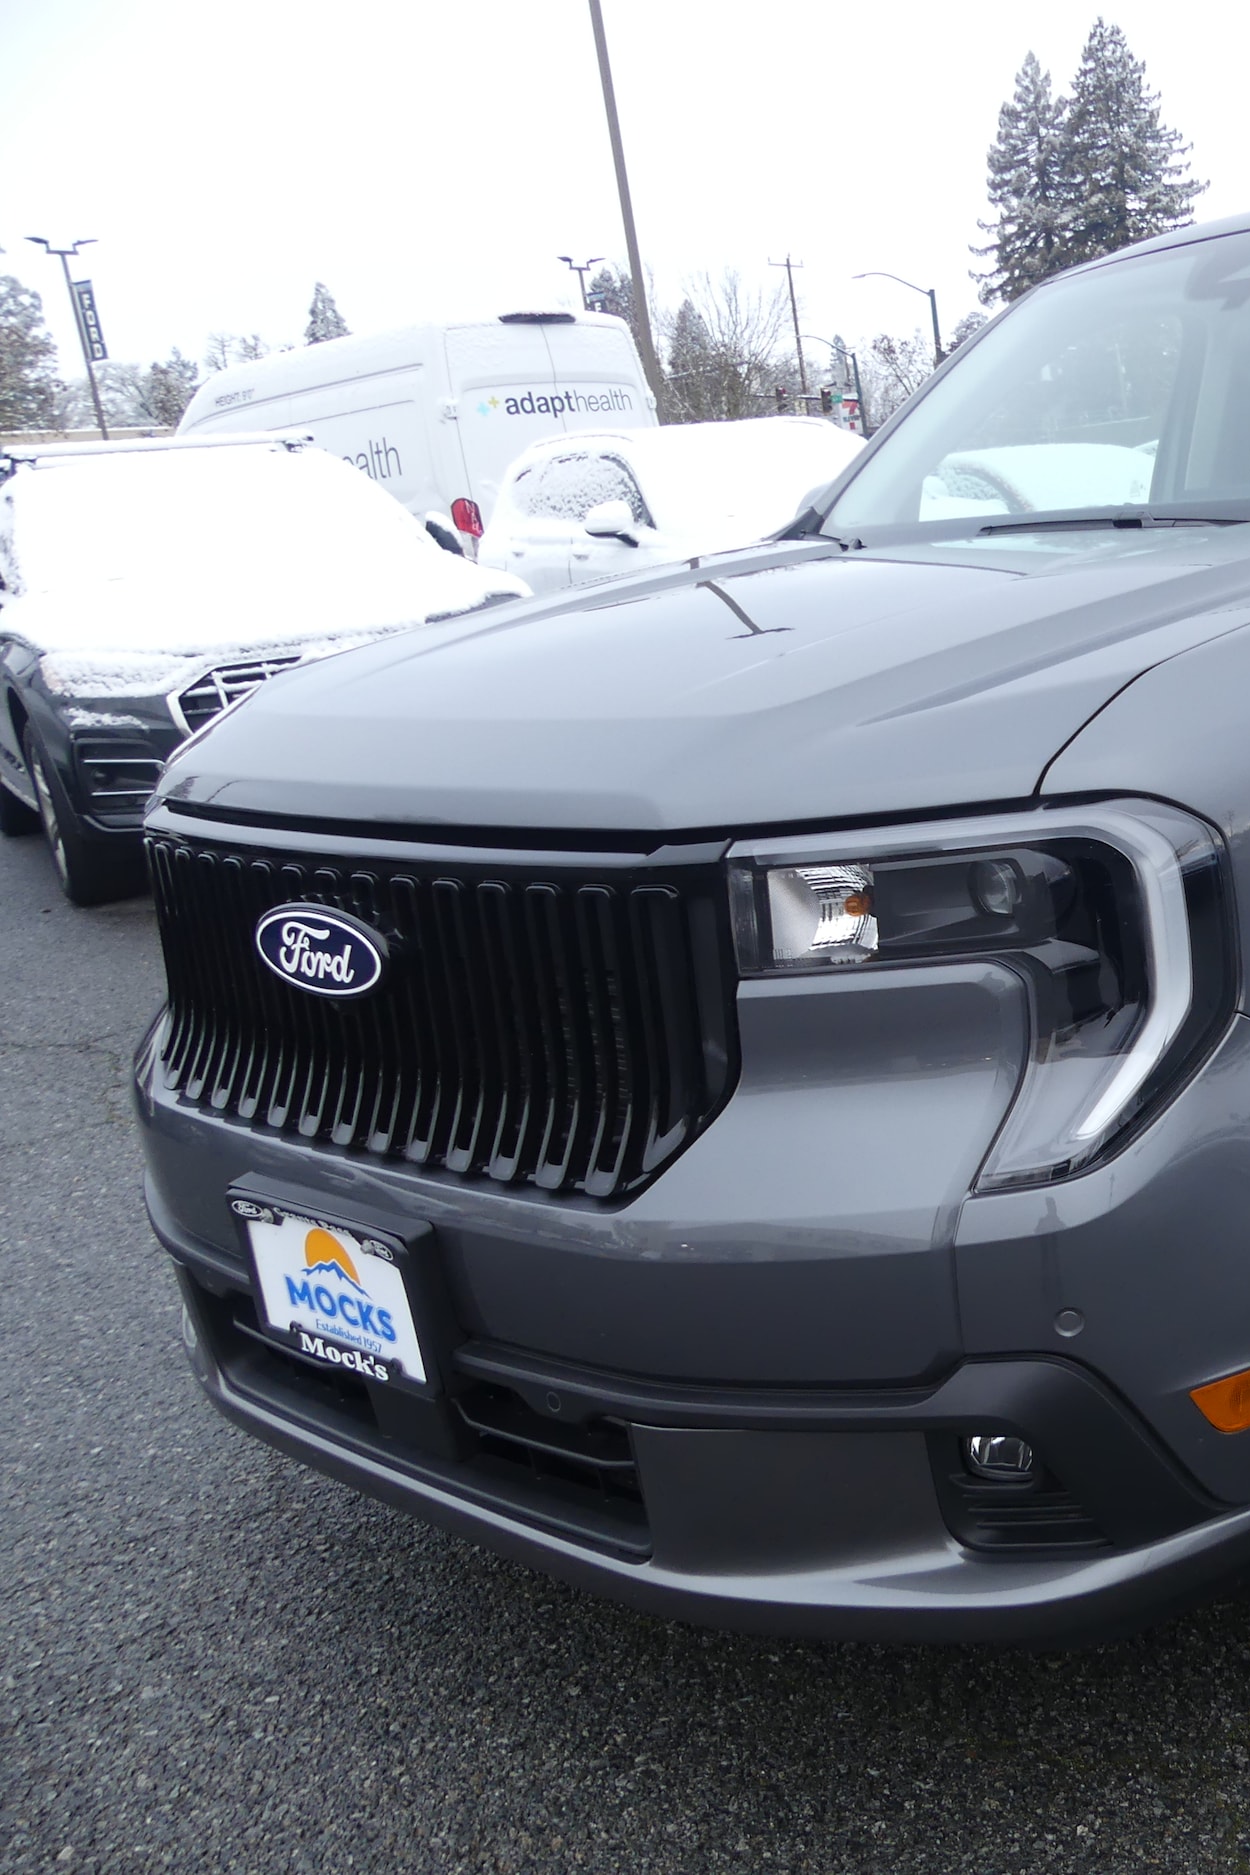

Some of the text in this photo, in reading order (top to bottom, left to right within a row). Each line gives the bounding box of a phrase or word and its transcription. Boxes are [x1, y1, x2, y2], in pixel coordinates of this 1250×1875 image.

[81, 293, 104, 359] FORD
[504, 388, 634, 419] adapthealth
[279, 920, 356, 984] Ford
[283, 1273, 398, 1344] MOCKS
[315, 1318, 383, 1354] Established 1957
[300, 1332, 390, 1381] Mock's
